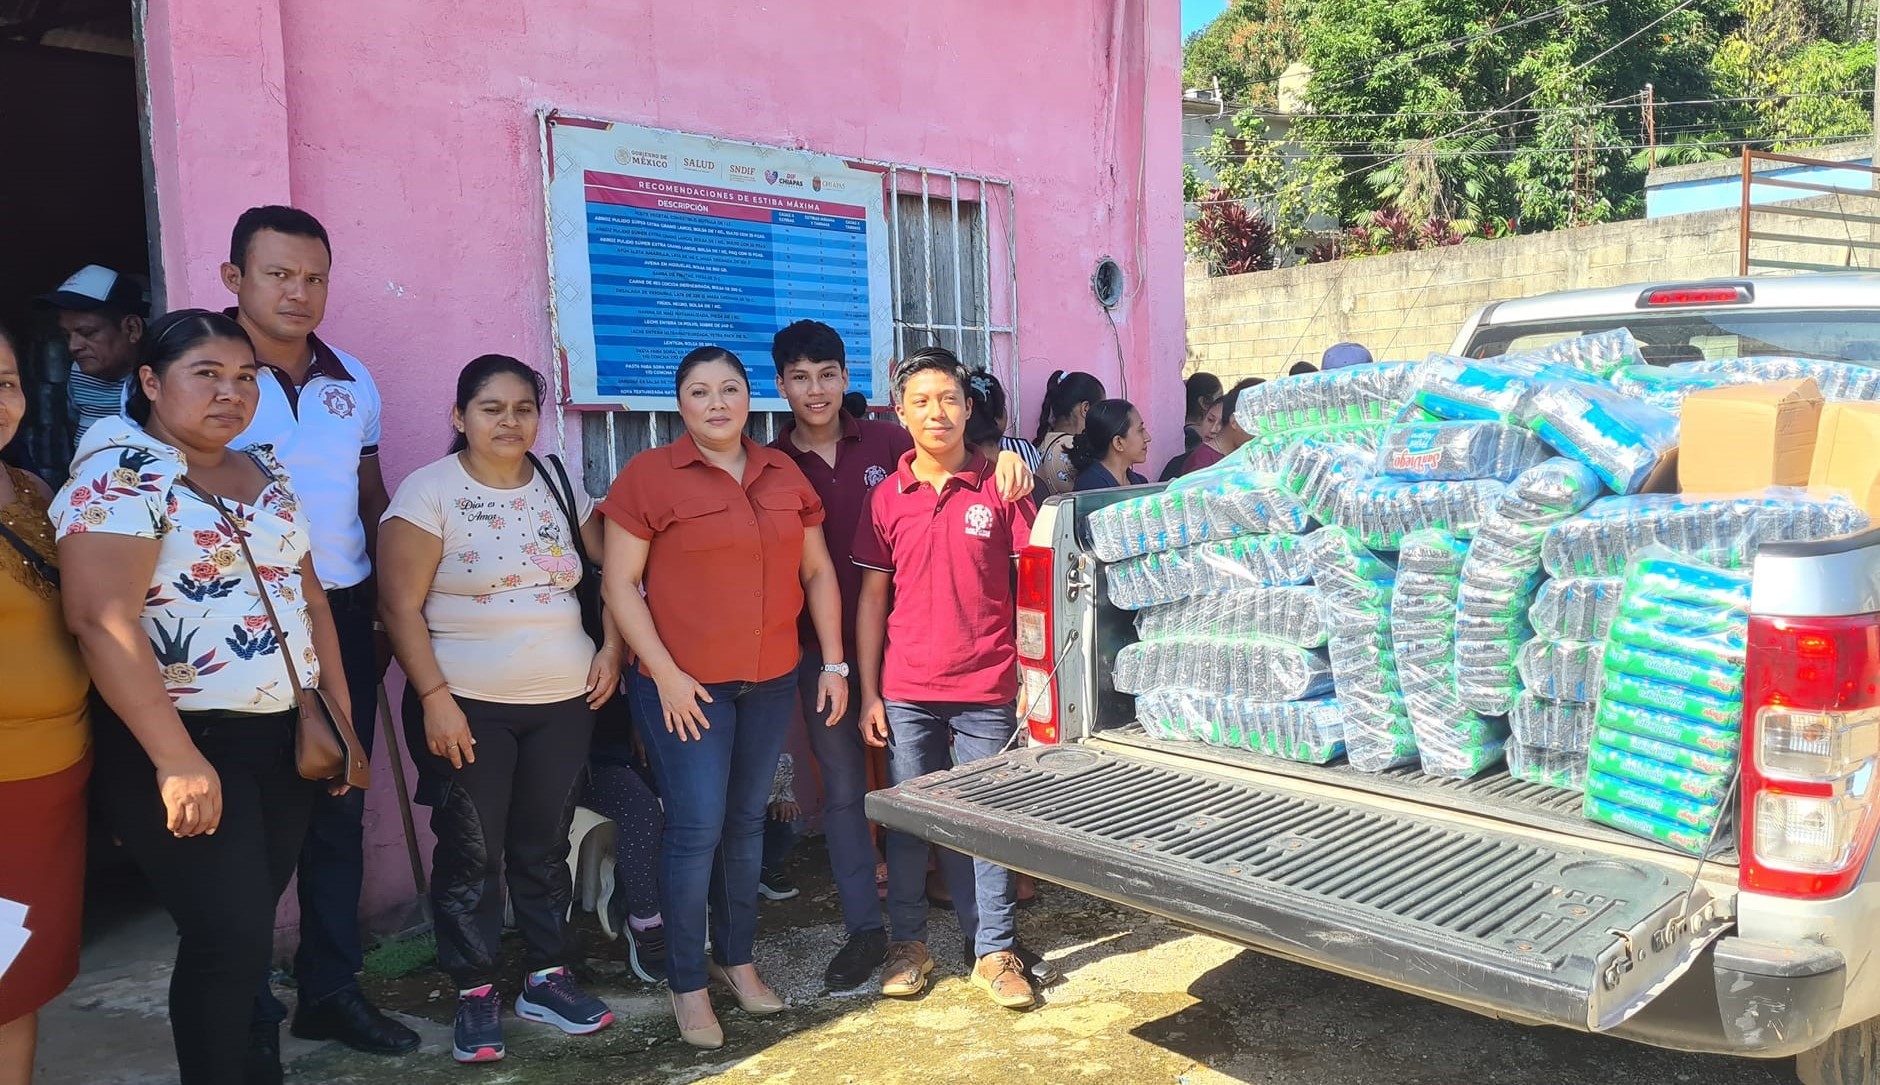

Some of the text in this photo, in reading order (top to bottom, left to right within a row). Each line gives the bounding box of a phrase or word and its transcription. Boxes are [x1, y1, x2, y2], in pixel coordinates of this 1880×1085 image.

[632, 156, 668, 168] MÉXICO
[683, 158, 715, 170] SALUD
[730, 164, 756, 176] SNDIF
[778, 178, 803, 187] CHIAPAS
[639, 181, 820, 211] RECOMENDACIONES DE ESTIBA MÁXIMA
[658, 200, 709, 213] DESCRIPCIÓN
[460, 500, 484, 510] Dios
[468, 511, 496, 521] Amor
